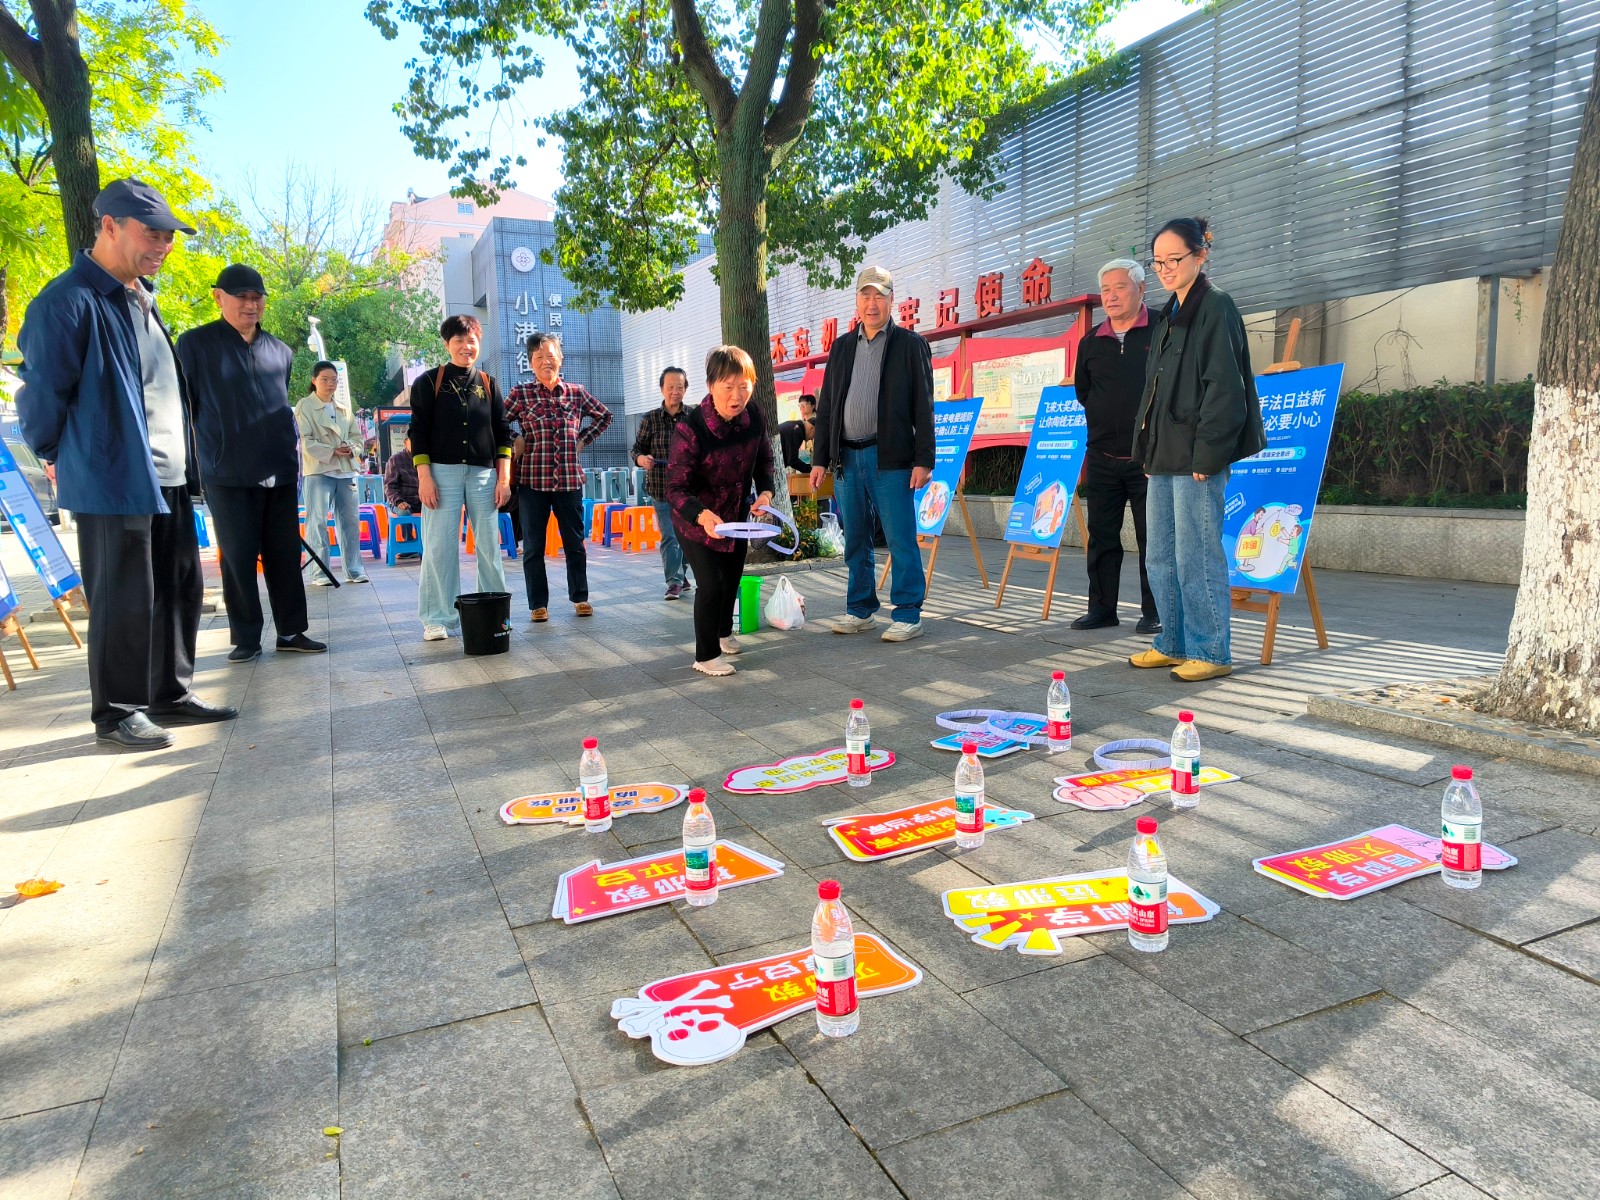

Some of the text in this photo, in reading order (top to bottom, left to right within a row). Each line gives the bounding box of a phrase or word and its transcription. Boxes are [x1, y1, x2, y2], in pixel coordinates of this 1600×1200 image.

[898, 257, 1053, 331] 牢记使命
[1262, 410, 1321, 431] 必要小心
